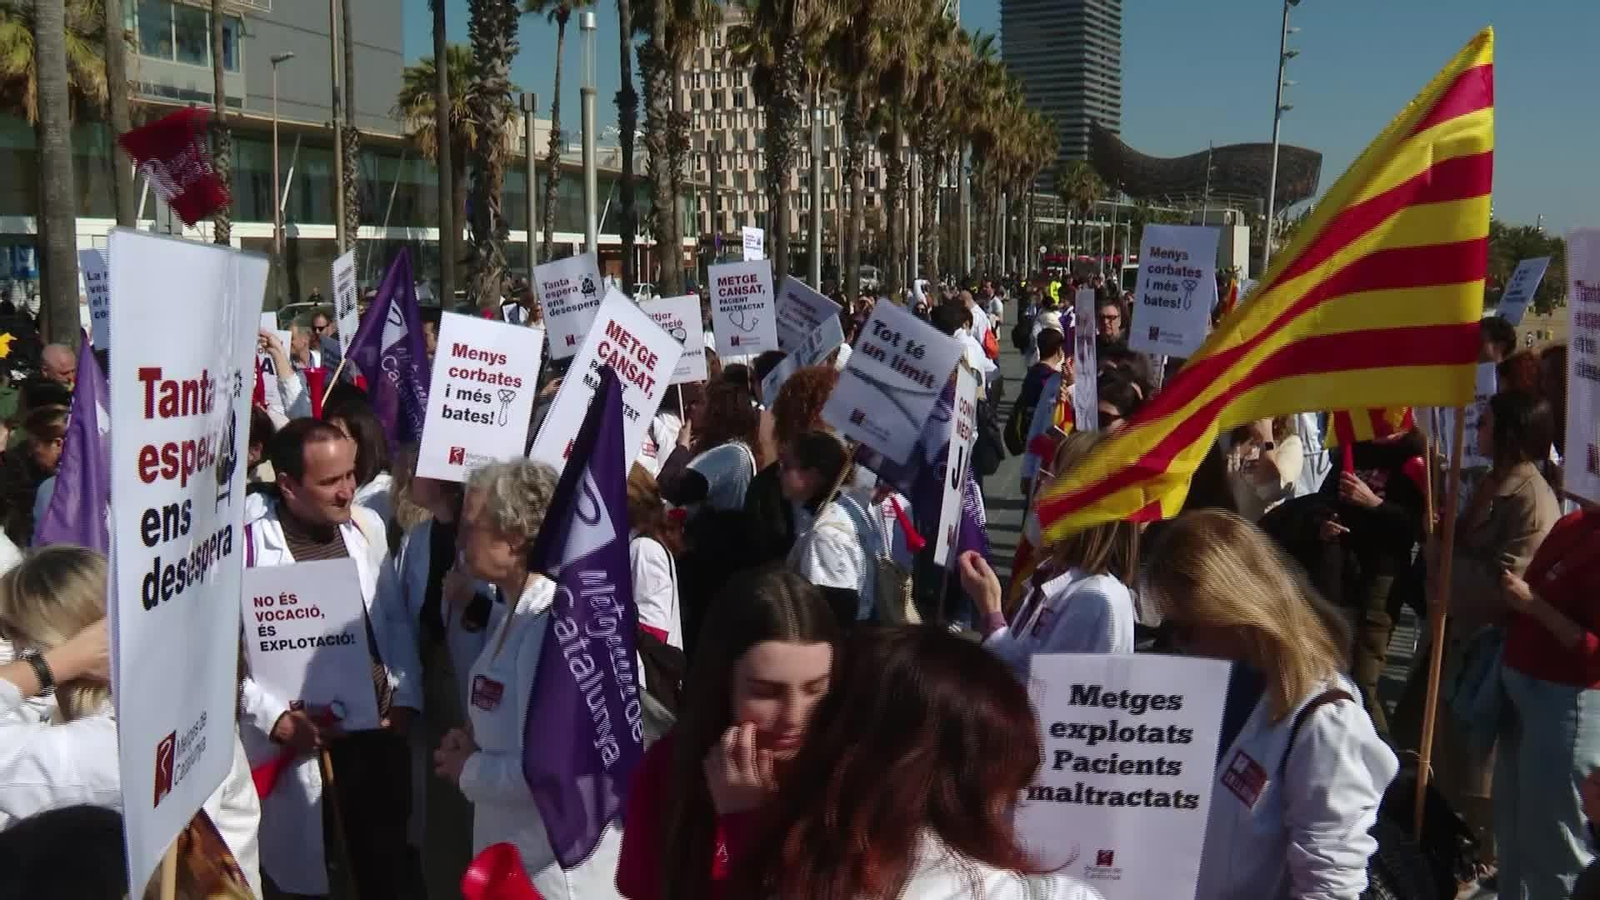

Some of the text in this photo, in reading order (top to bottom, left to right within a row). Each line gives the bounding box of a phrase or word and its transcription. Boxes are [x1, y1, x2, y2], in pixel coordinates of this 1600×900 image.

[1149, 246, 1189, 262] Menys
[718, 274, 758, 287] METGE
[1147, 264, 1203, 279] corbates
[543, 279, 570, 291] Tanta
[545, 286, 578, 299] espera
[718, 284, 766, 298] CANSAT,
[1153, 280, 1179, 292] més
[547, 299, 564, 308] ens
[549, 299, 600, 317] desespera
[719, 296, 749, 305] PACIENT
[719, 302, 765, 313] MALTRACTAT
[1143, 293, 1181, 309] bates!
[661, 319, 683, 329] nció
[872, 319, 902, 348] Tot
[451, 342, 507, 366] Menys
[605, 319, 659, 372] METGE
[861, 341, 887, 363] un
[448, 366, 523, 388] corbates
[597, 341, 656, 400] CANSAT,
[444, 383, 492, 404] i més
[441, 404, 495, 425] bates!
[141, 498, 192, 547] ens
[141, 523, 233, 611] desespera
[253, 592, 298, 607] NO ÉS
[255, 604, 325, 622] VOCACIÓ,
[258, 623, 276, 637] ÉS
[260, 633, 356, 652] EXPLOTACIÓ!
[1067, 684, 1184, 716] Metges
[1049, 719, 1194, 746] explotats
[1052, 749, 1183, 776] Pacients
[1026, 781, 1200, 809] maltractats
